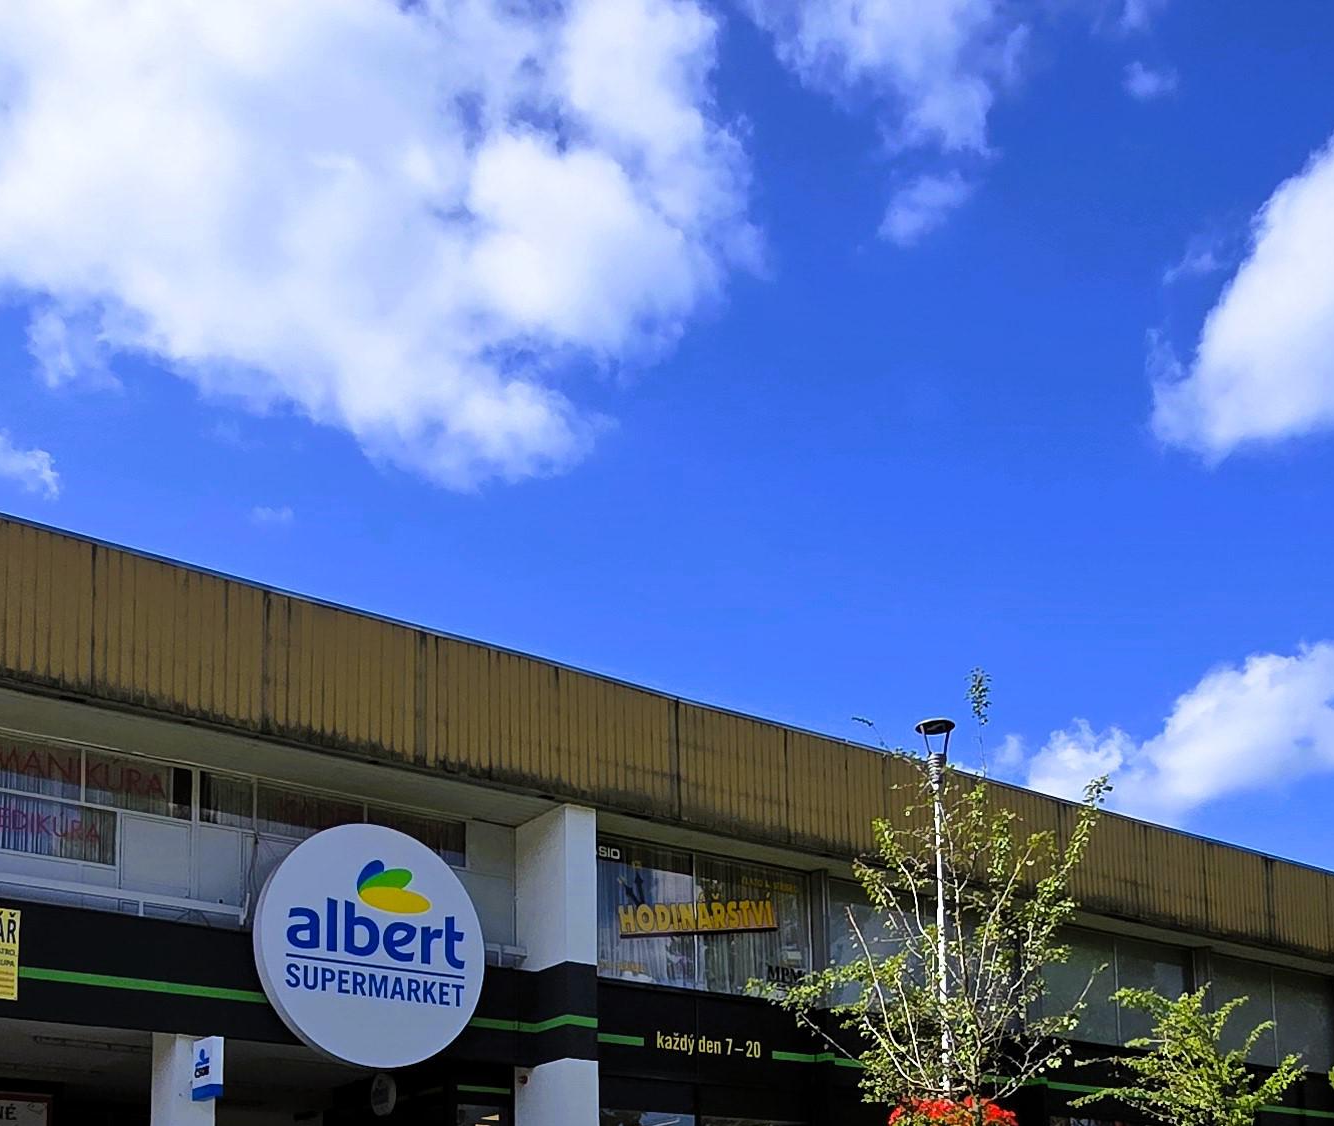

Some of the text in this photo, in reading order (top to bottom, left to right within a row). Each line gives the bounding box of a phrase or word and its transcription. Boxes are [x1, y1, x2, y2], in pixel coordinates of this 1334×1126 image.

[597, 847, 620, 860] SIO
[286, 896, 465, 970] albert
[618, 893, 777, 933] HODINÁŘSTVÍ
[285, 962, 465, 1008] SUPERMARKET
[656, 1031, 695, 1055] každý
[698, 1035, 722, 1055] den
